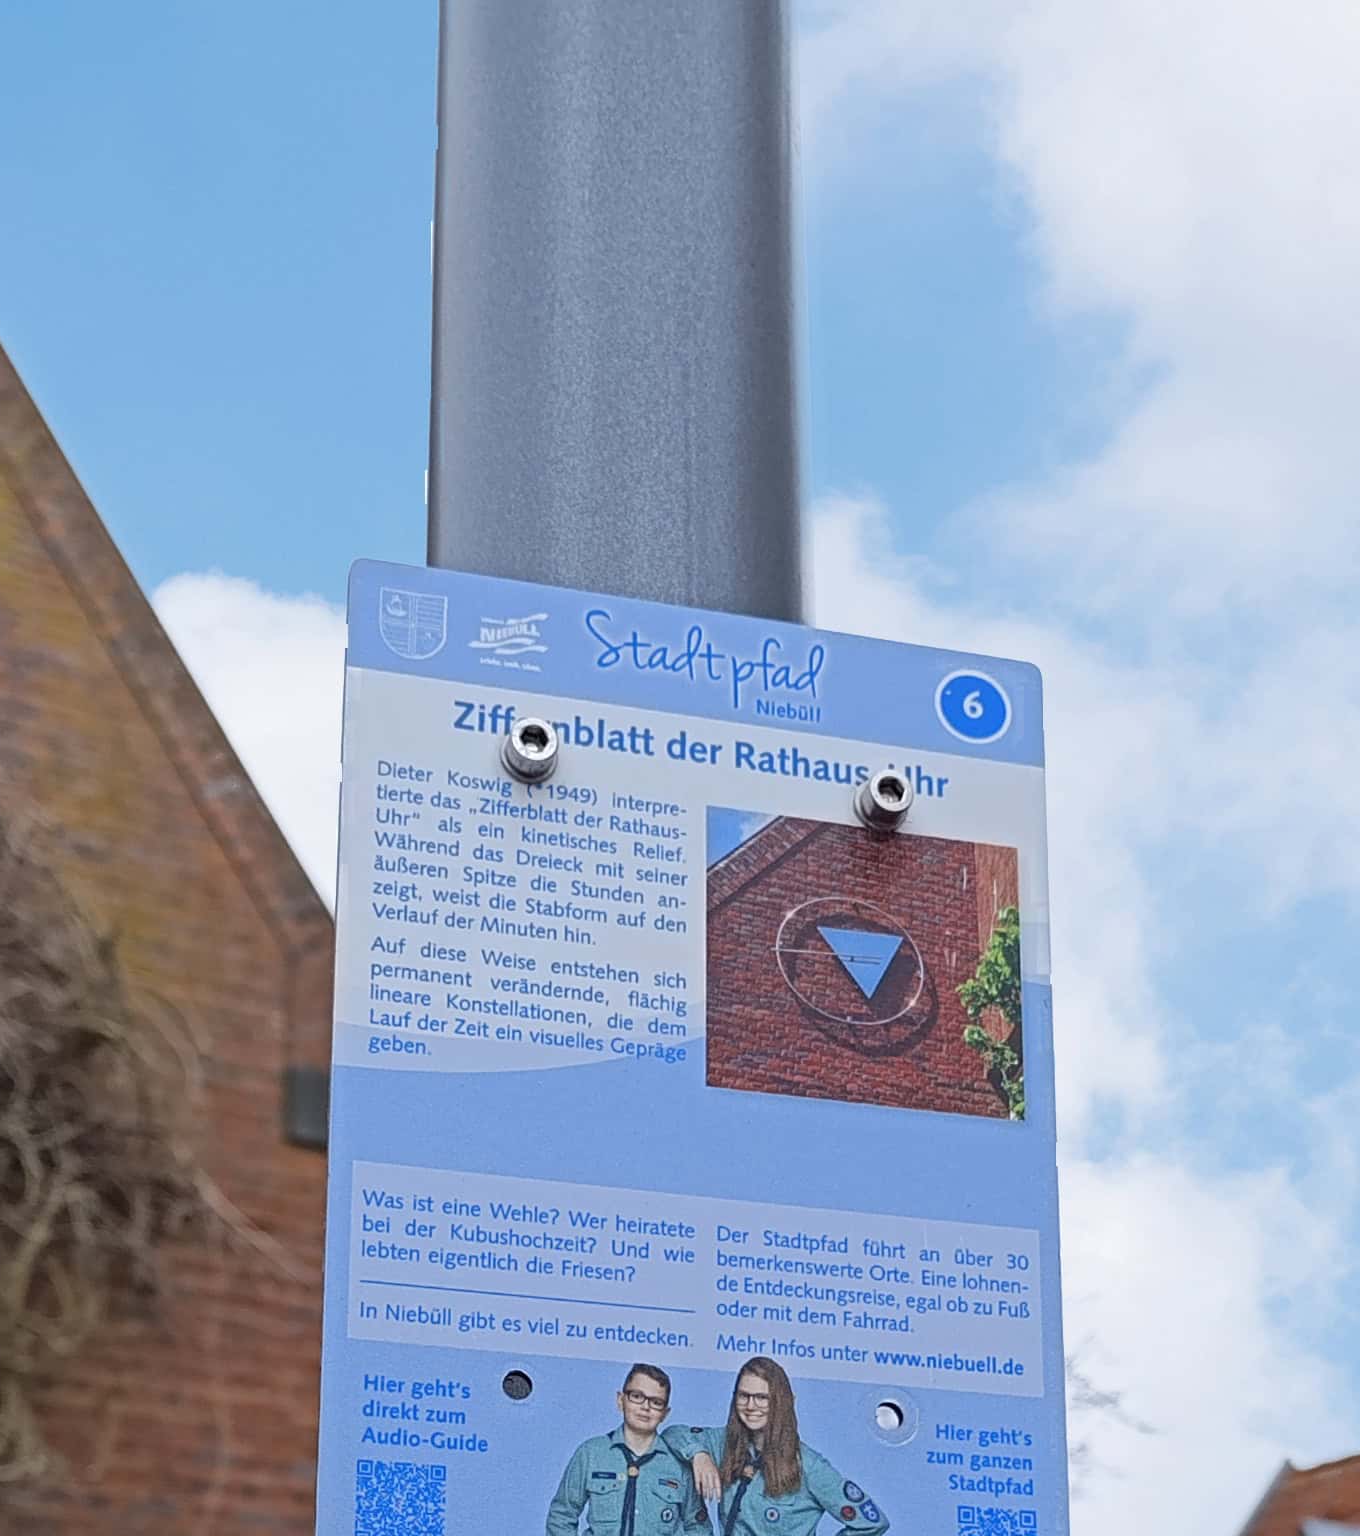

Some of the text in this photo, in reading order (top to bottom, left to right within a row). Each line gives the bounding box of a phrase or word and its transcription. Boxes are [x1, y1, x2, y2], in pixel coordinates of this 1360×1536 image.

[755, 698, 822, 724] Niebüll
[962, 690, 984, 720] 6
[453, 700, 655, 757] Ziffnblatt
[666, 730, 724, 766] der
[371, 936, 686, 989] Auf diese Weise entstehen sich
[371, 963, 687, 1017] permanent verändernde, flächig
[370, 982, 686, 1037] lineare Konstellationen, die dem
[370, 1008, 687, 1064] Lauf der Zeit ein visuelles Gepräge
[716, 1334, 1024, 1376] Mehr Infos unter www.niebuell.de
[364, 1374, 405, 1393] Hier
[362, 1399, 466, 1424] direkt zum
[361, 1426, 488, 1453] Audio-Guide
[936, 1424, 973, 1441] Hier
[926, 1451, 1032, 1472] zum ganzen
[949, 1474, 1034, 1498] Stadtpfad
